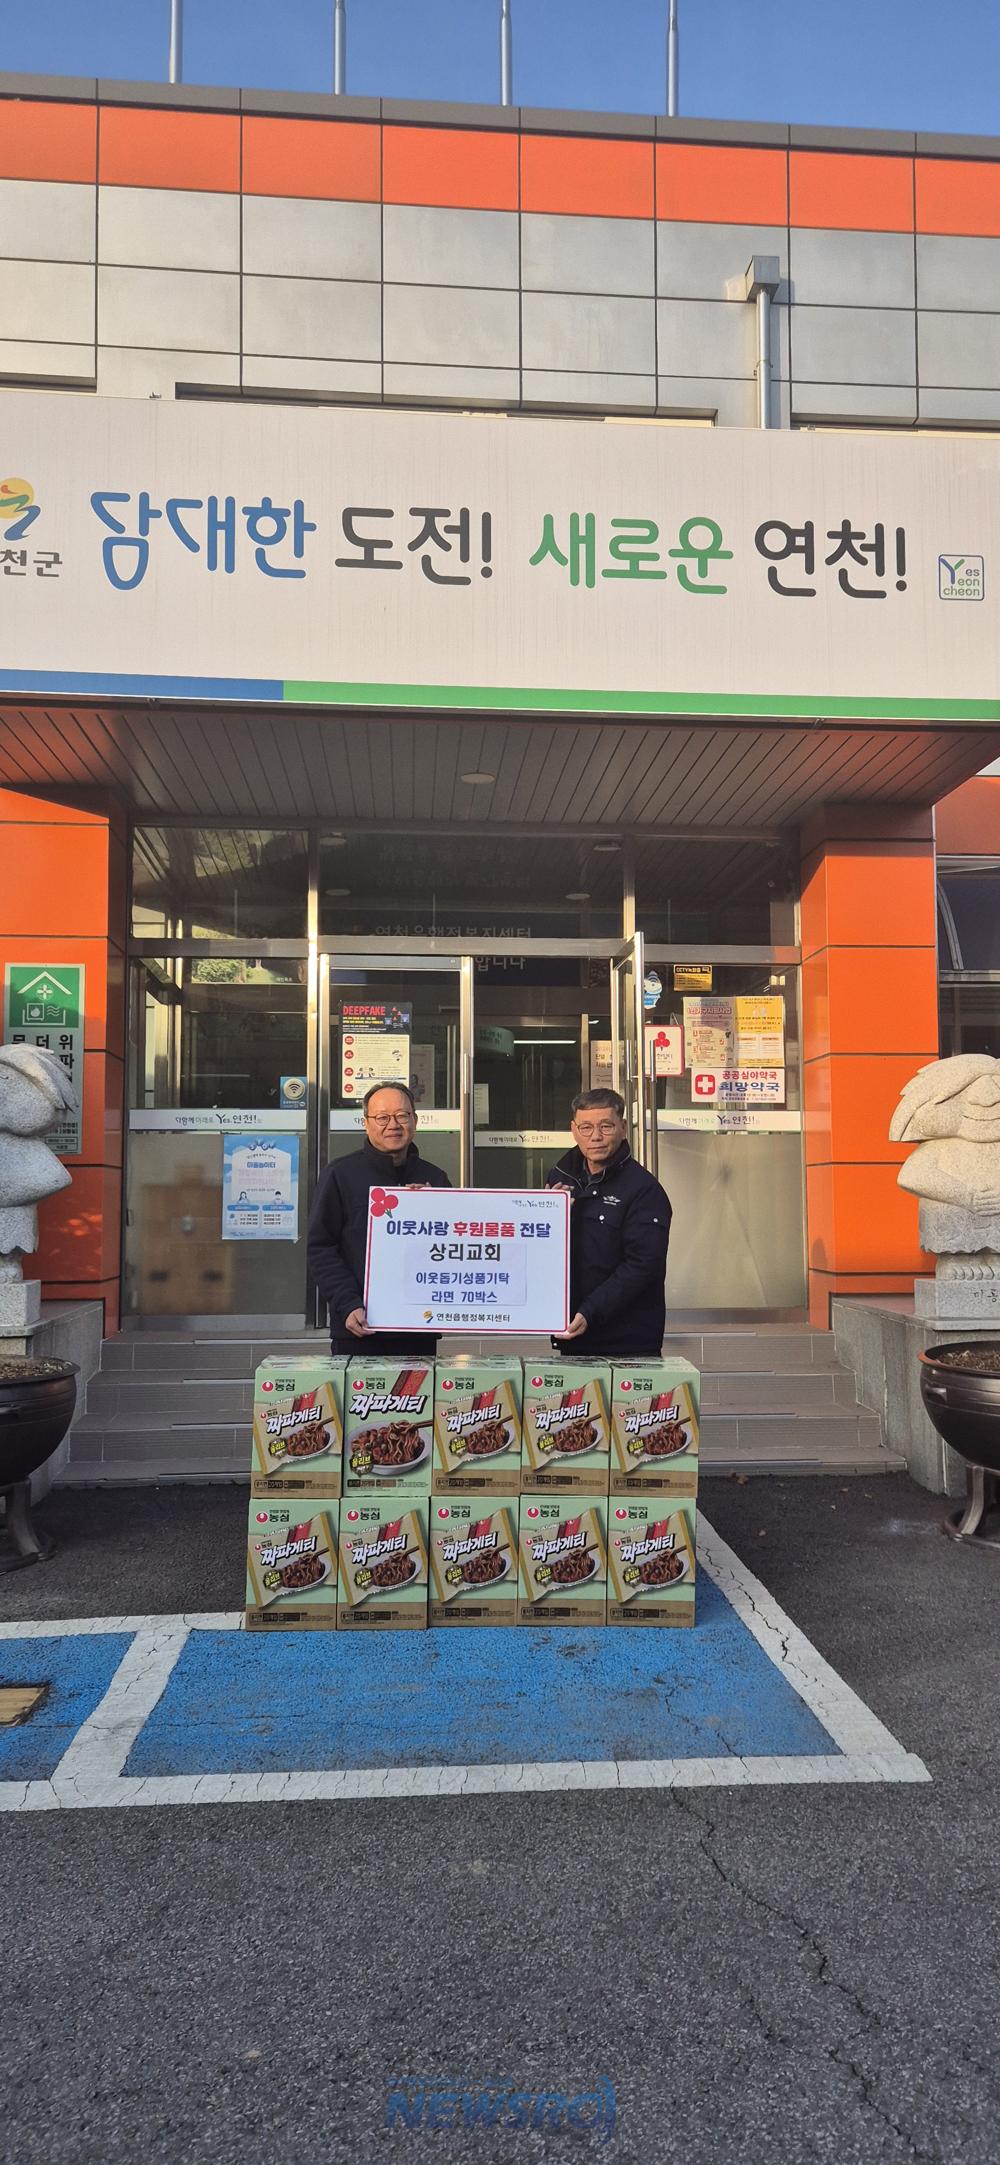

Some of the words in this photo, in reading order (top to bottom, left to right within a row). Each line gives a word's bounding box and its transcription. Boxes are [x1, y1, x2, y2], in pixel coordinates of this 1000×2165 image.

[90, 490, 317, 591] 담대한
[334, 506, 493, 585] 도전!
[529, 512, 734, 594] 새로운
[754, 519, 908, 599] 연천!
[943, 586, 980, 597] cheon
[342, 1005, 385, 1016] DEEPFAKE
[722, 1070, 777, 1080] 공공심야약국
[719, 1081, 780, 1092] 희망약국
[386, 1219, 449, 1236] 이웃사랑
[453, 1221, 516, 1238] 후원물품
[520, 1222, 551, 1239] 전달
[429, 1243, 502, 1262] 상리교회
[415, 1271, 510, 1286] 이웃돕기성품기탁
[431, 1290, 455, 1304] 라면
[461, 1290, 498, 1304] 70박스
[436, 1312, 511, 1323] 연천읍행정복지센터
[275, 1383, 295, 1391] 농심
[365, 1382, 386, 1390] 농심
[455, 1381, 474, 1390] 농심
[544, 1378, 563, 1387] 농심
[633, 1382, 652, 1391] 농심
[350, 1393, 428, 1419] 짜파게티
[266, 1405, 323, 1435] 짜파게티
[447, 1402, 501, 1434] 짜파게티
[535, 1402, 590, 1431] 짜파게티
[625, 1405, 679, 1434] 짜파게티
[352, 1457, 371, 1466] 올리브
[269, 1514, 289, 1522] 농심
[360, 1512, 380, 1520] 농심
[451, 1509, 471, 1518] 농심
[540, 1509, 560, 1517] 농심
[628, 1510, 648, 1519] 농심
[261, 1536, 317, 1567] 짜파게티
[352, 1534, 408, 1565] 짜파게티
[443, 1532, 498, 1562] 짜파게티
[532, 1532, 587, 1563] 짜파게티
[620, 1534, 676, 1564] 짜파게티
